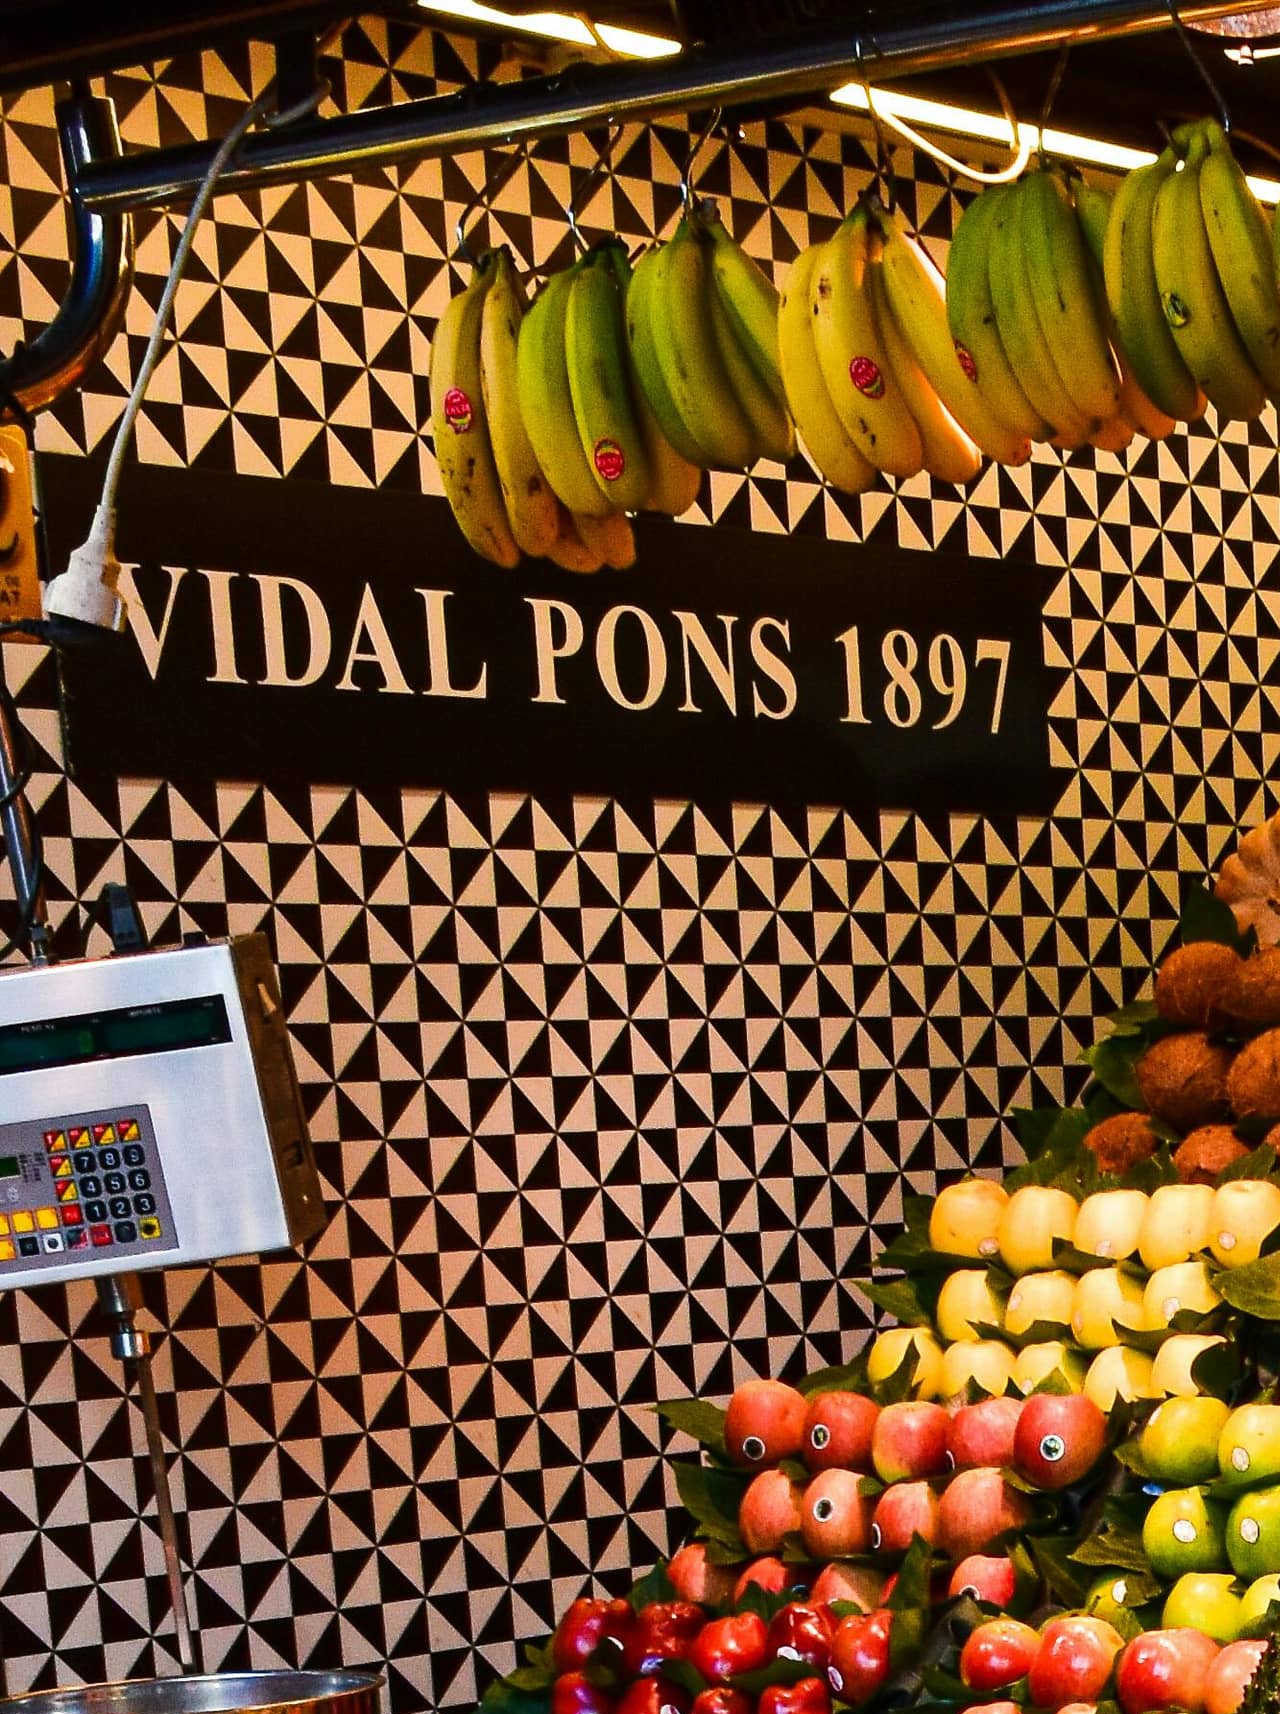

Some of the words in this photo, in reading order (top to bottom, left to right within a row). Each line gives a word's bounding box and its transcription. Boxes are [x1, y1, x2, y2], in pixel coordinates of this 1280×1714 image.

[116, 562, 488, 700] VIDAL
[523, 597, 798, 720] PONS
[834, 625, 1011, 734] 1897
[80, 1157, 90, 1168] 7
[105, 1153, 115, 1165] 8
[129, 1150, 139, 1162] 9
[86, 1181, 96, 1192] 4
[111, 1178, 120, 1190] 5
[135, 1174, 144, 1186] 6
[92, 1206, 100, 1217] 1
[116, 1202, 125, 1214] 2
[141, 1198, 150, 1211] 3
